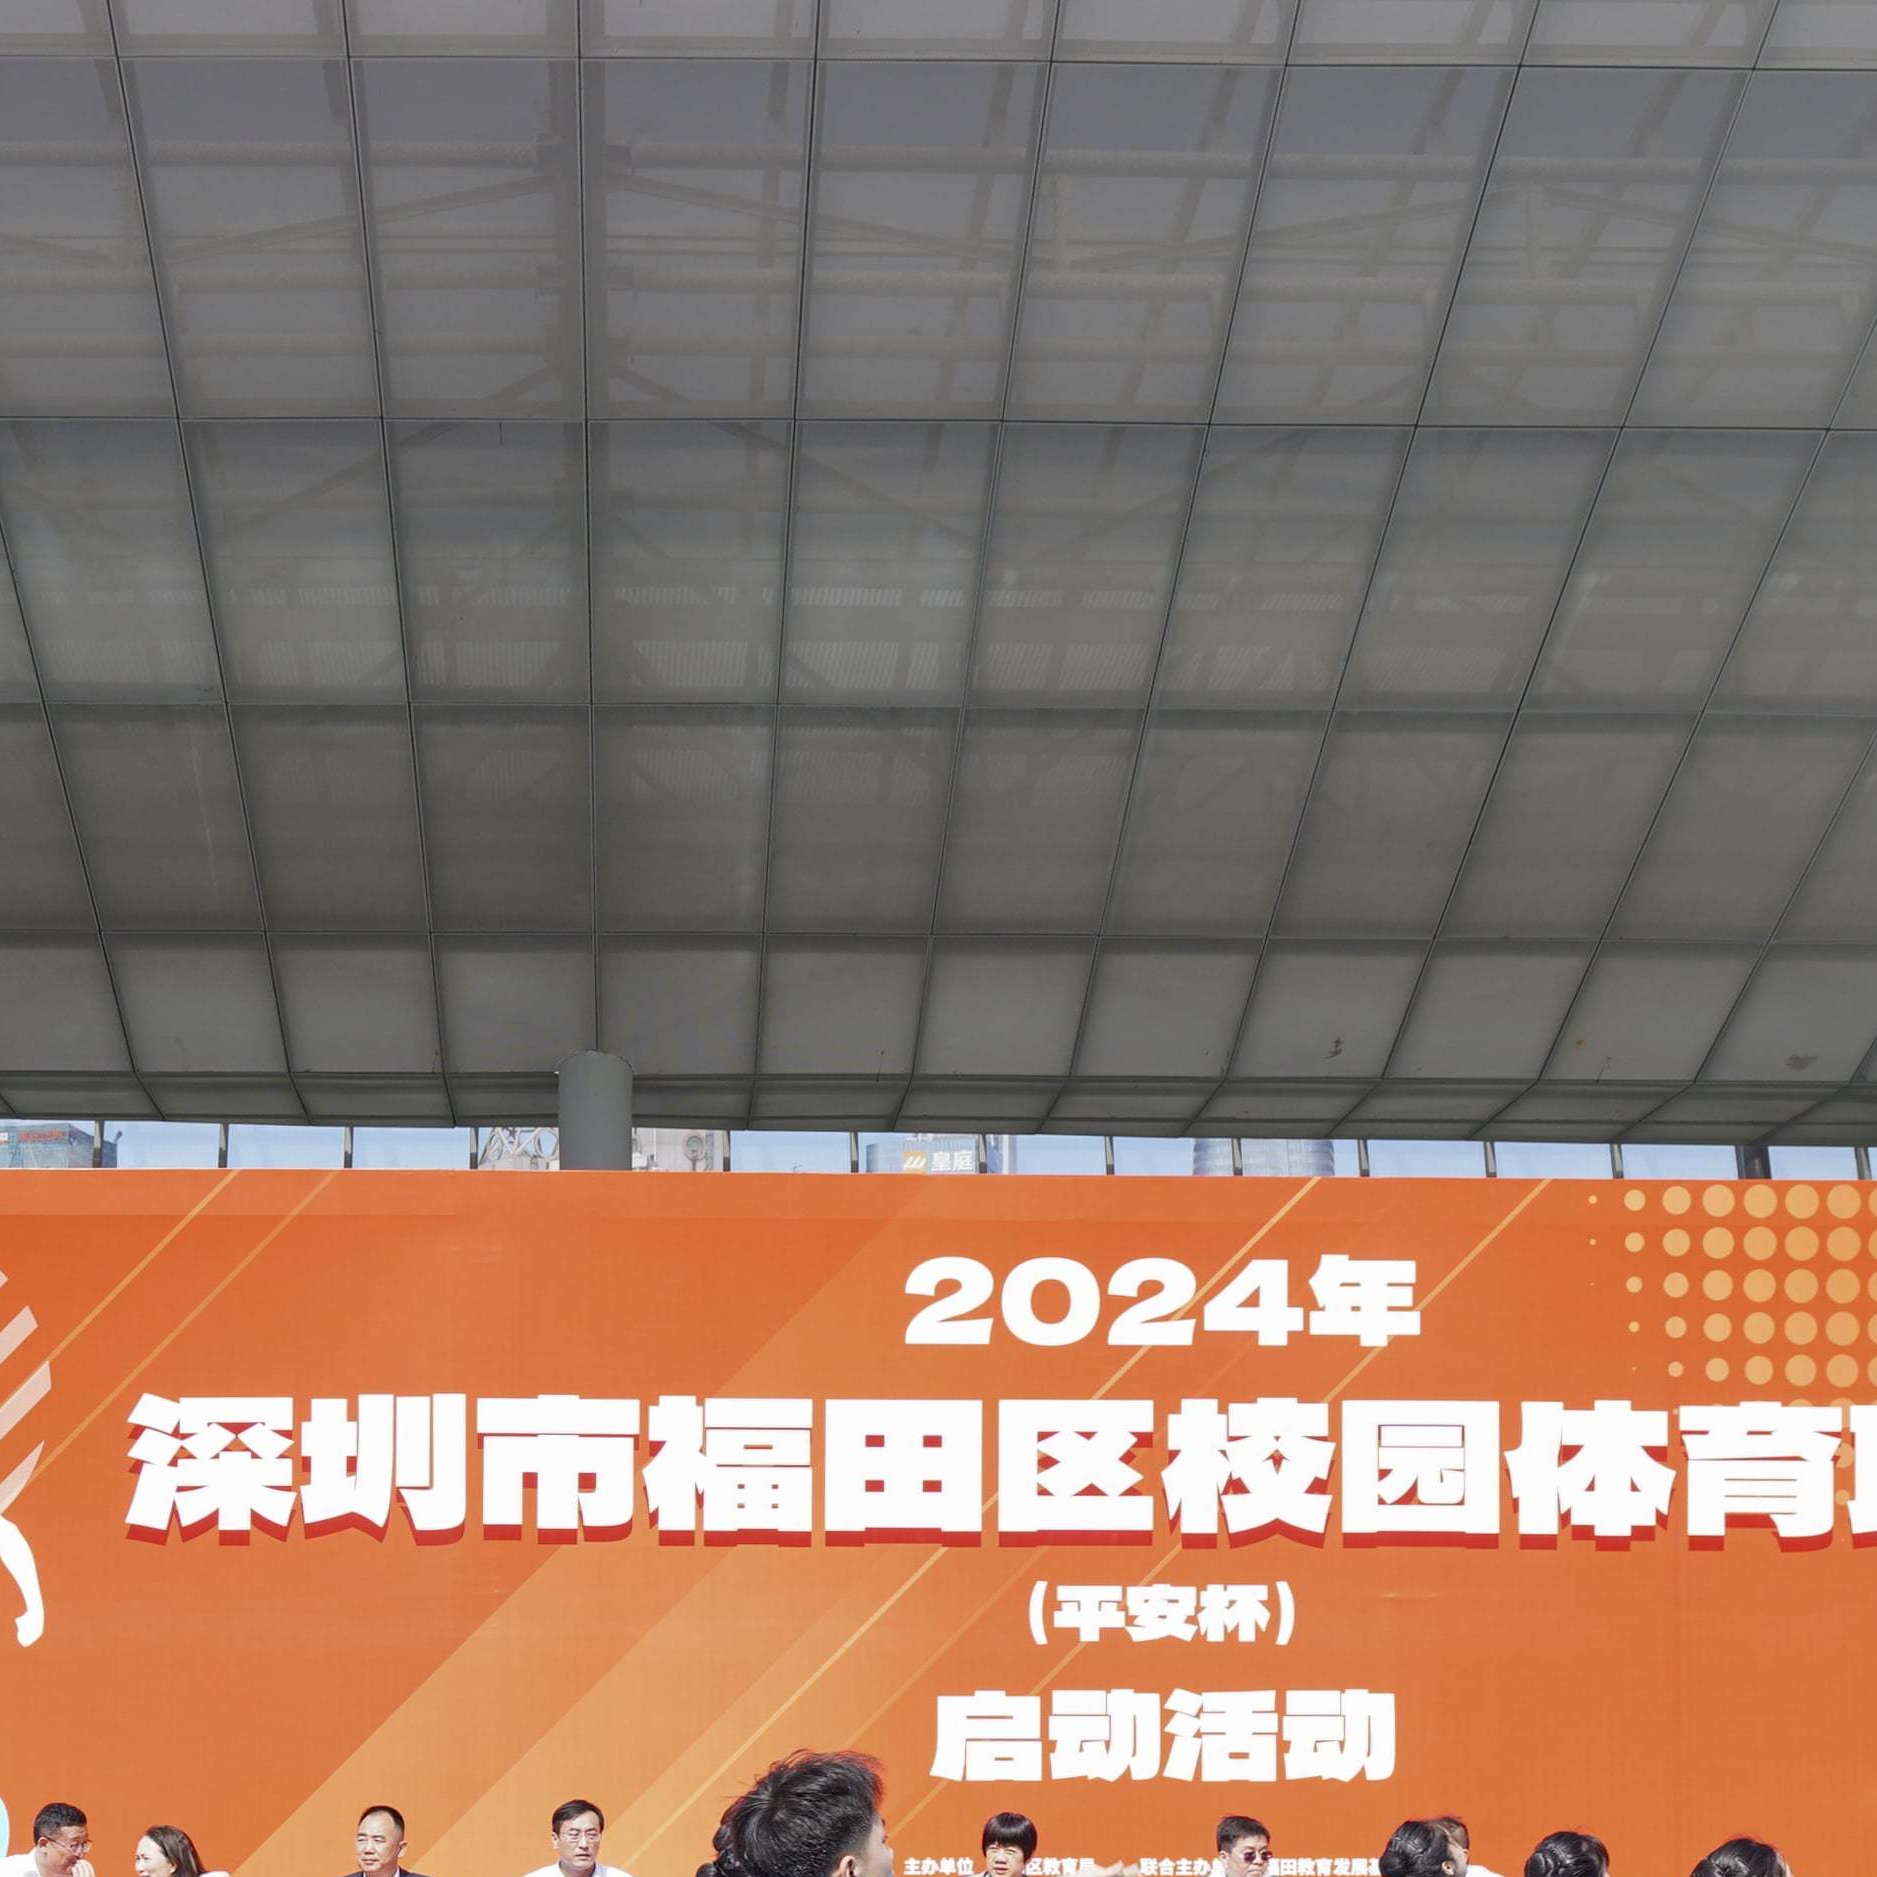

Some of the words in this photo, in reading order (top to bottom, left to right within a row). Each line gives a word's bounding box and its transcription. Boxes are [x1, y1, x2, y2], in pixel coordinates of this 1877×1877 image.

[904, 1253, 1421, 1348] 2024年
[1028, 1580, 1296, 1646] (平安杯)
[929, 1688, 1397, 1783] 启动活动
[903, 1856, 975, 1877] 主办单位
